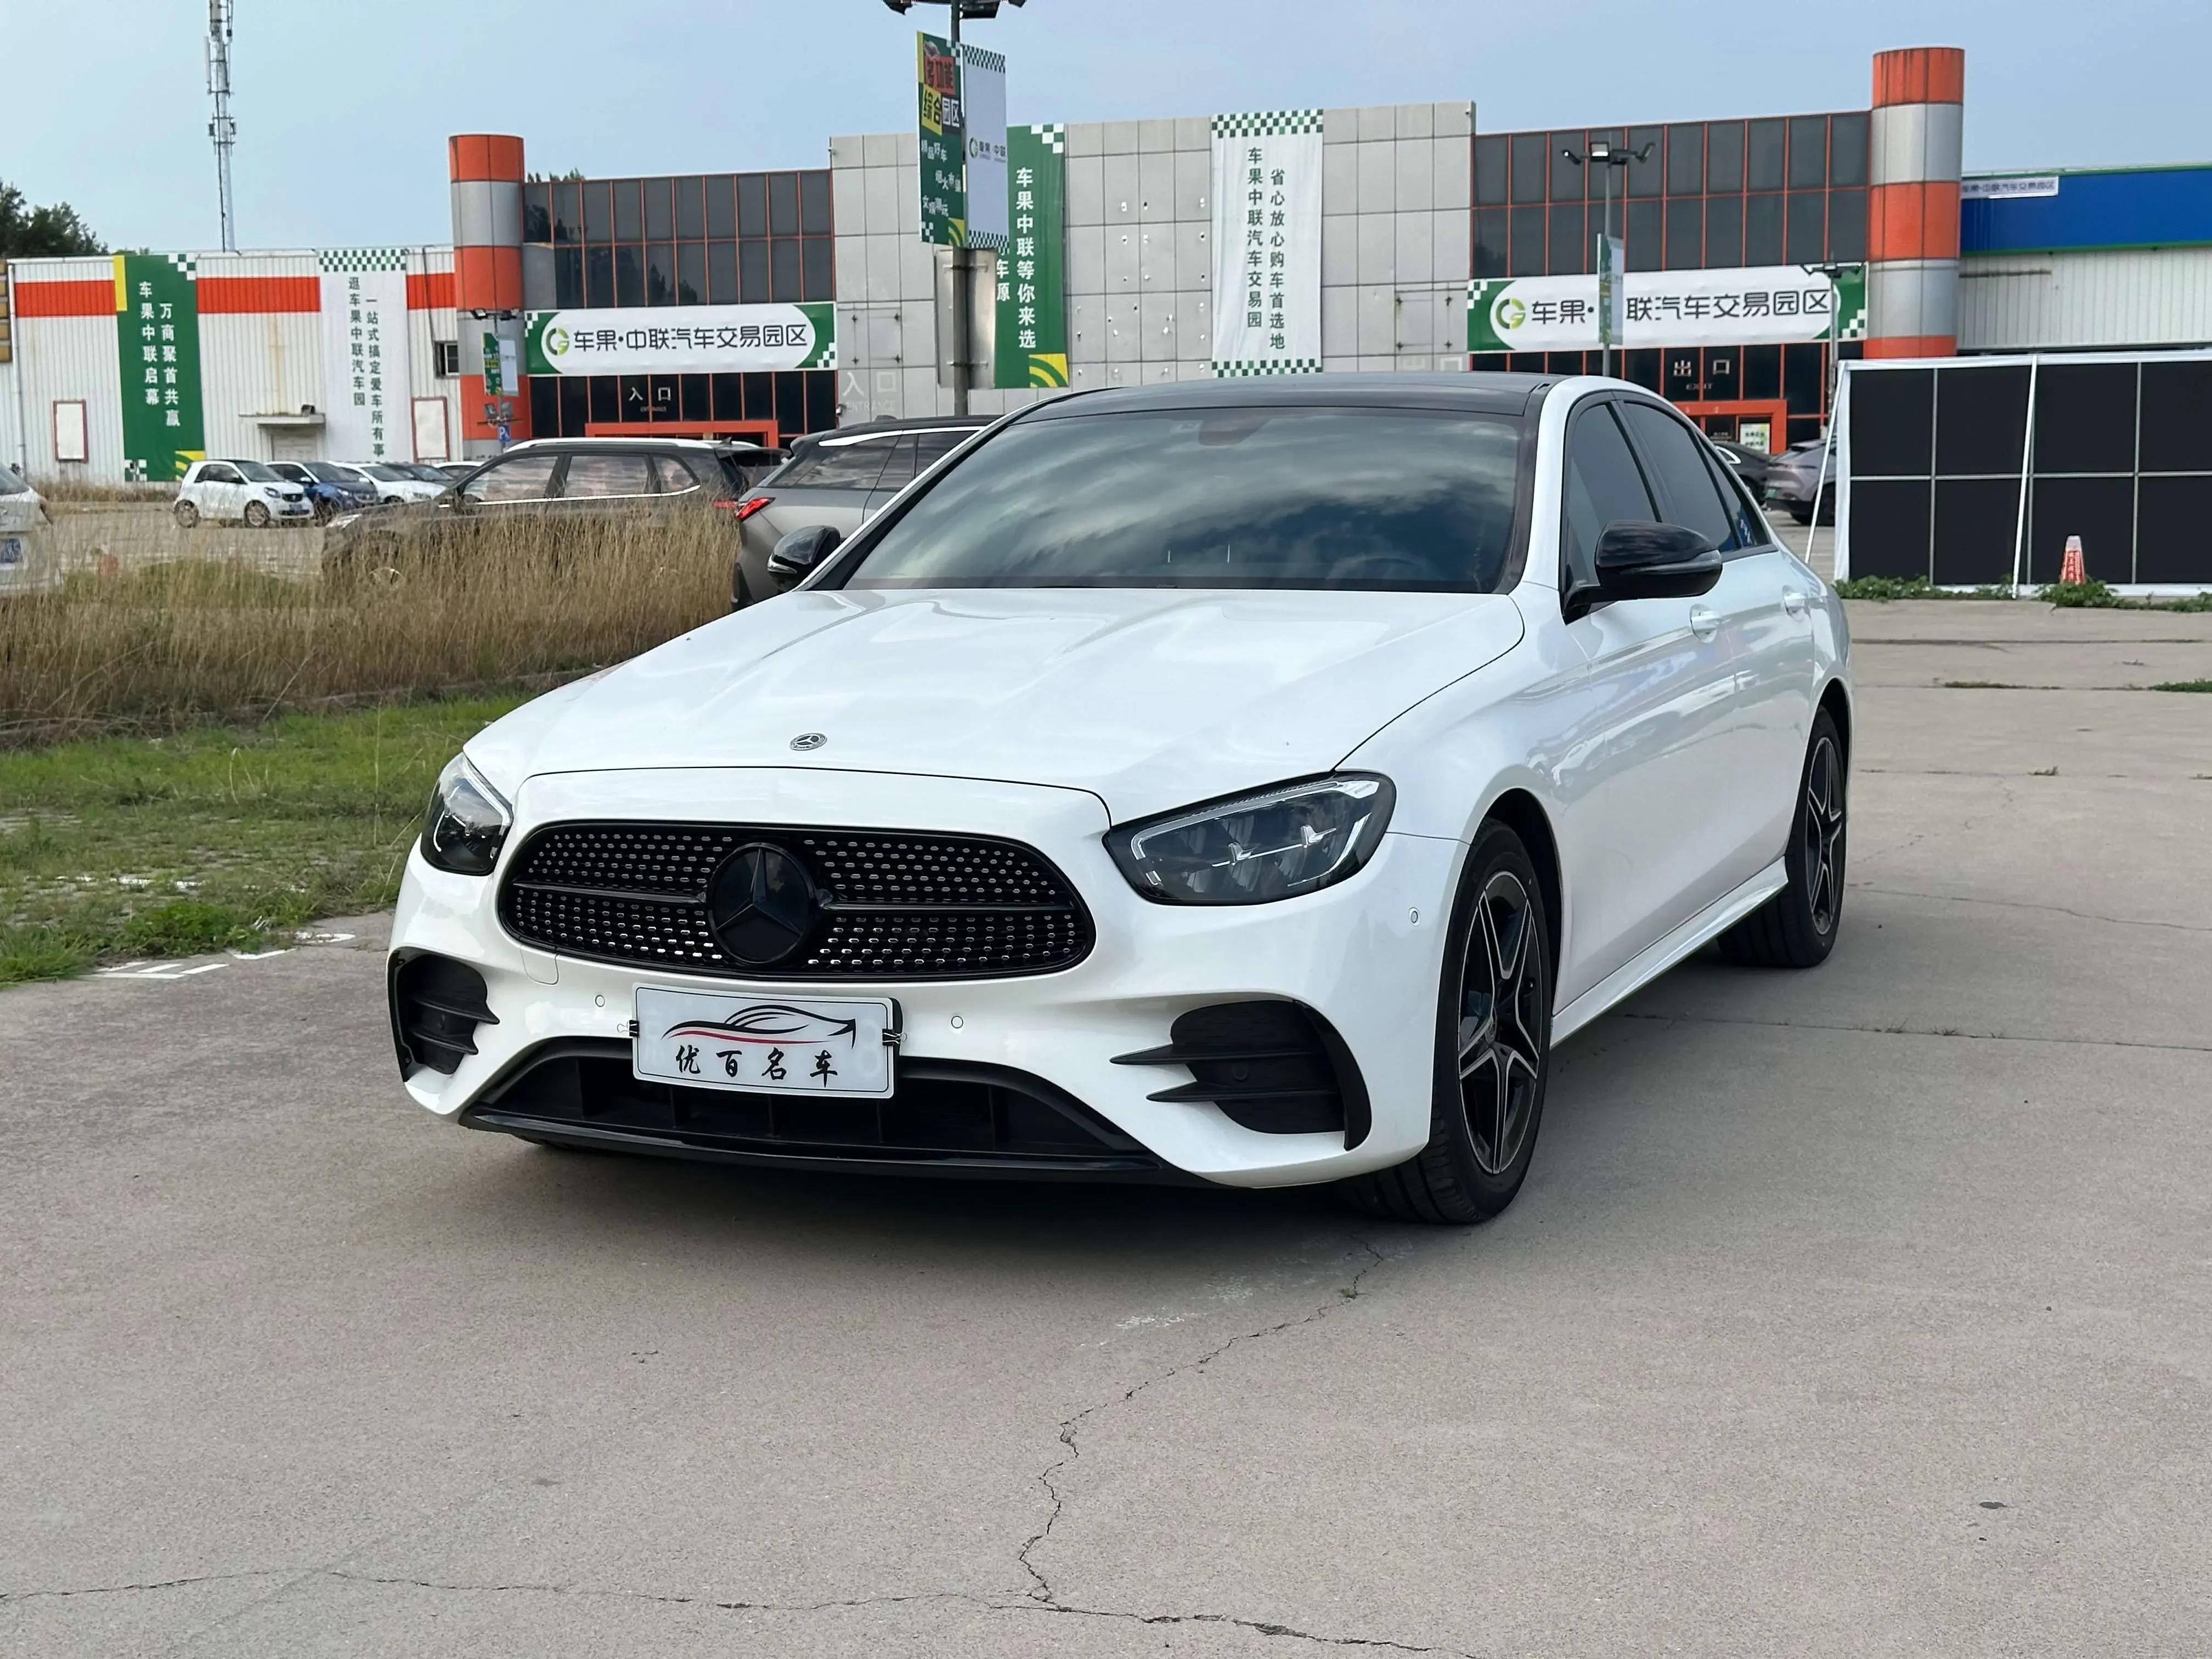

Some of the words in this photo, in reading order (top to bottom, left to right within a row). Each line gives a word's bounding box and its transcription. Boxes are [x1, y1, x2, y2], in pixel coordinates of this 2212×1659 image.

[1016, 167, 1036, 349] 车果中联等你来选
[1247, 147, 1263, 328] 车果中联汽车交易园
[1269, 168, 1285, 350] 省心放心购车首选地
[139, 281, 160, 405] 车果中联启幕
[160, 303, 180, 427] 万商聚首共赢
[349, 276, 365, 407] 逛车果中联汽车园
[366, 299, 385, 458] 一站式搞定爱车所有事
[574, 324, 808, 352] 车果·中联汽车交易园区
[629, 387, 671, 401] 入口
[842, 371, 897, 397] 入口
[1673, 359, 1730, 377] 出口
[499, 426, 506, 439] P
[675, 1045, 838, 1088] 优百名车
